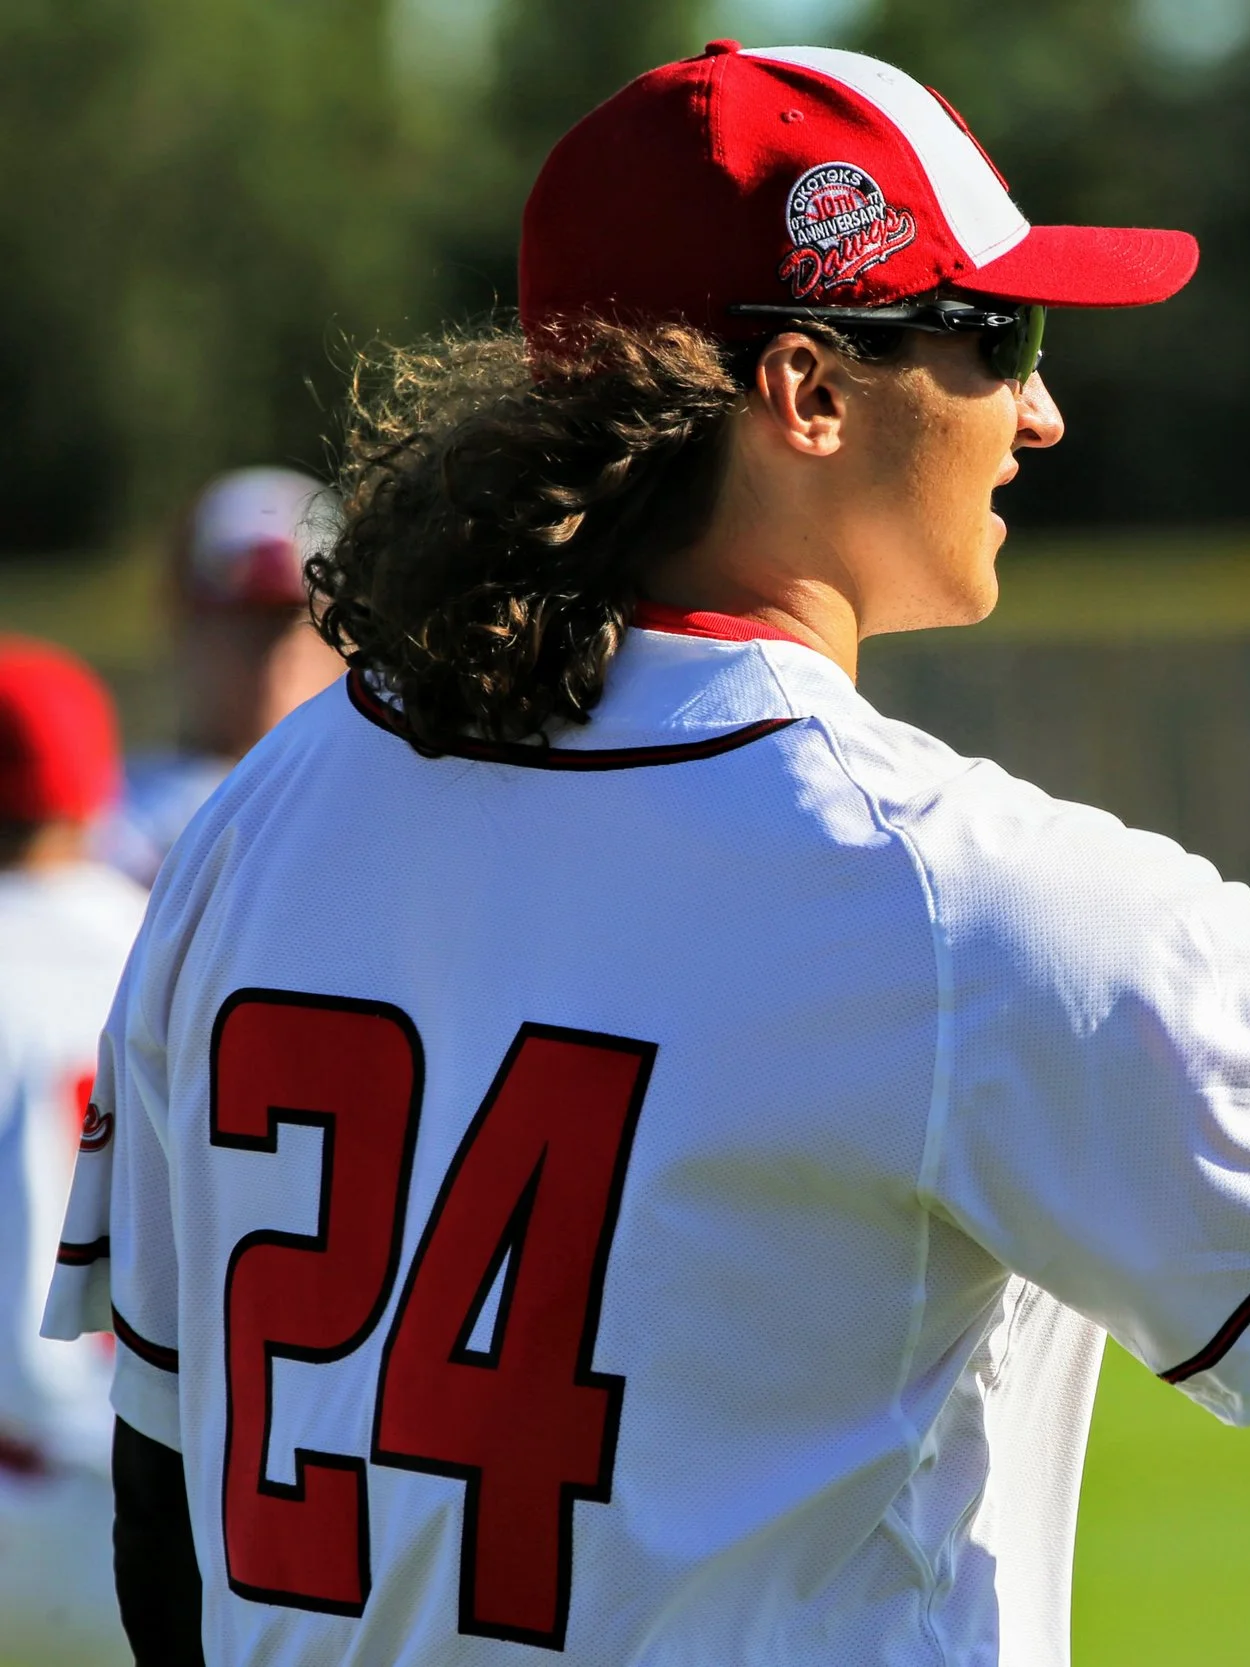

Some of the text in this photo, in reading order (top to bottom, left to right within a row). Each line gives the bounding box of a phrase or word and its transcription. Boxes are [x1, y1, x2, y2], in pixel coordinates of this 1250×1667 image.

[793, 169, 863, 212] OKOTOKS
[813, 193, 858, 220] 10TH
[795, 202, 886, 247] ANNIVERSARY
[779, 207, 917, 299] Dawgs
[210, 986, 660, 1652] 24
